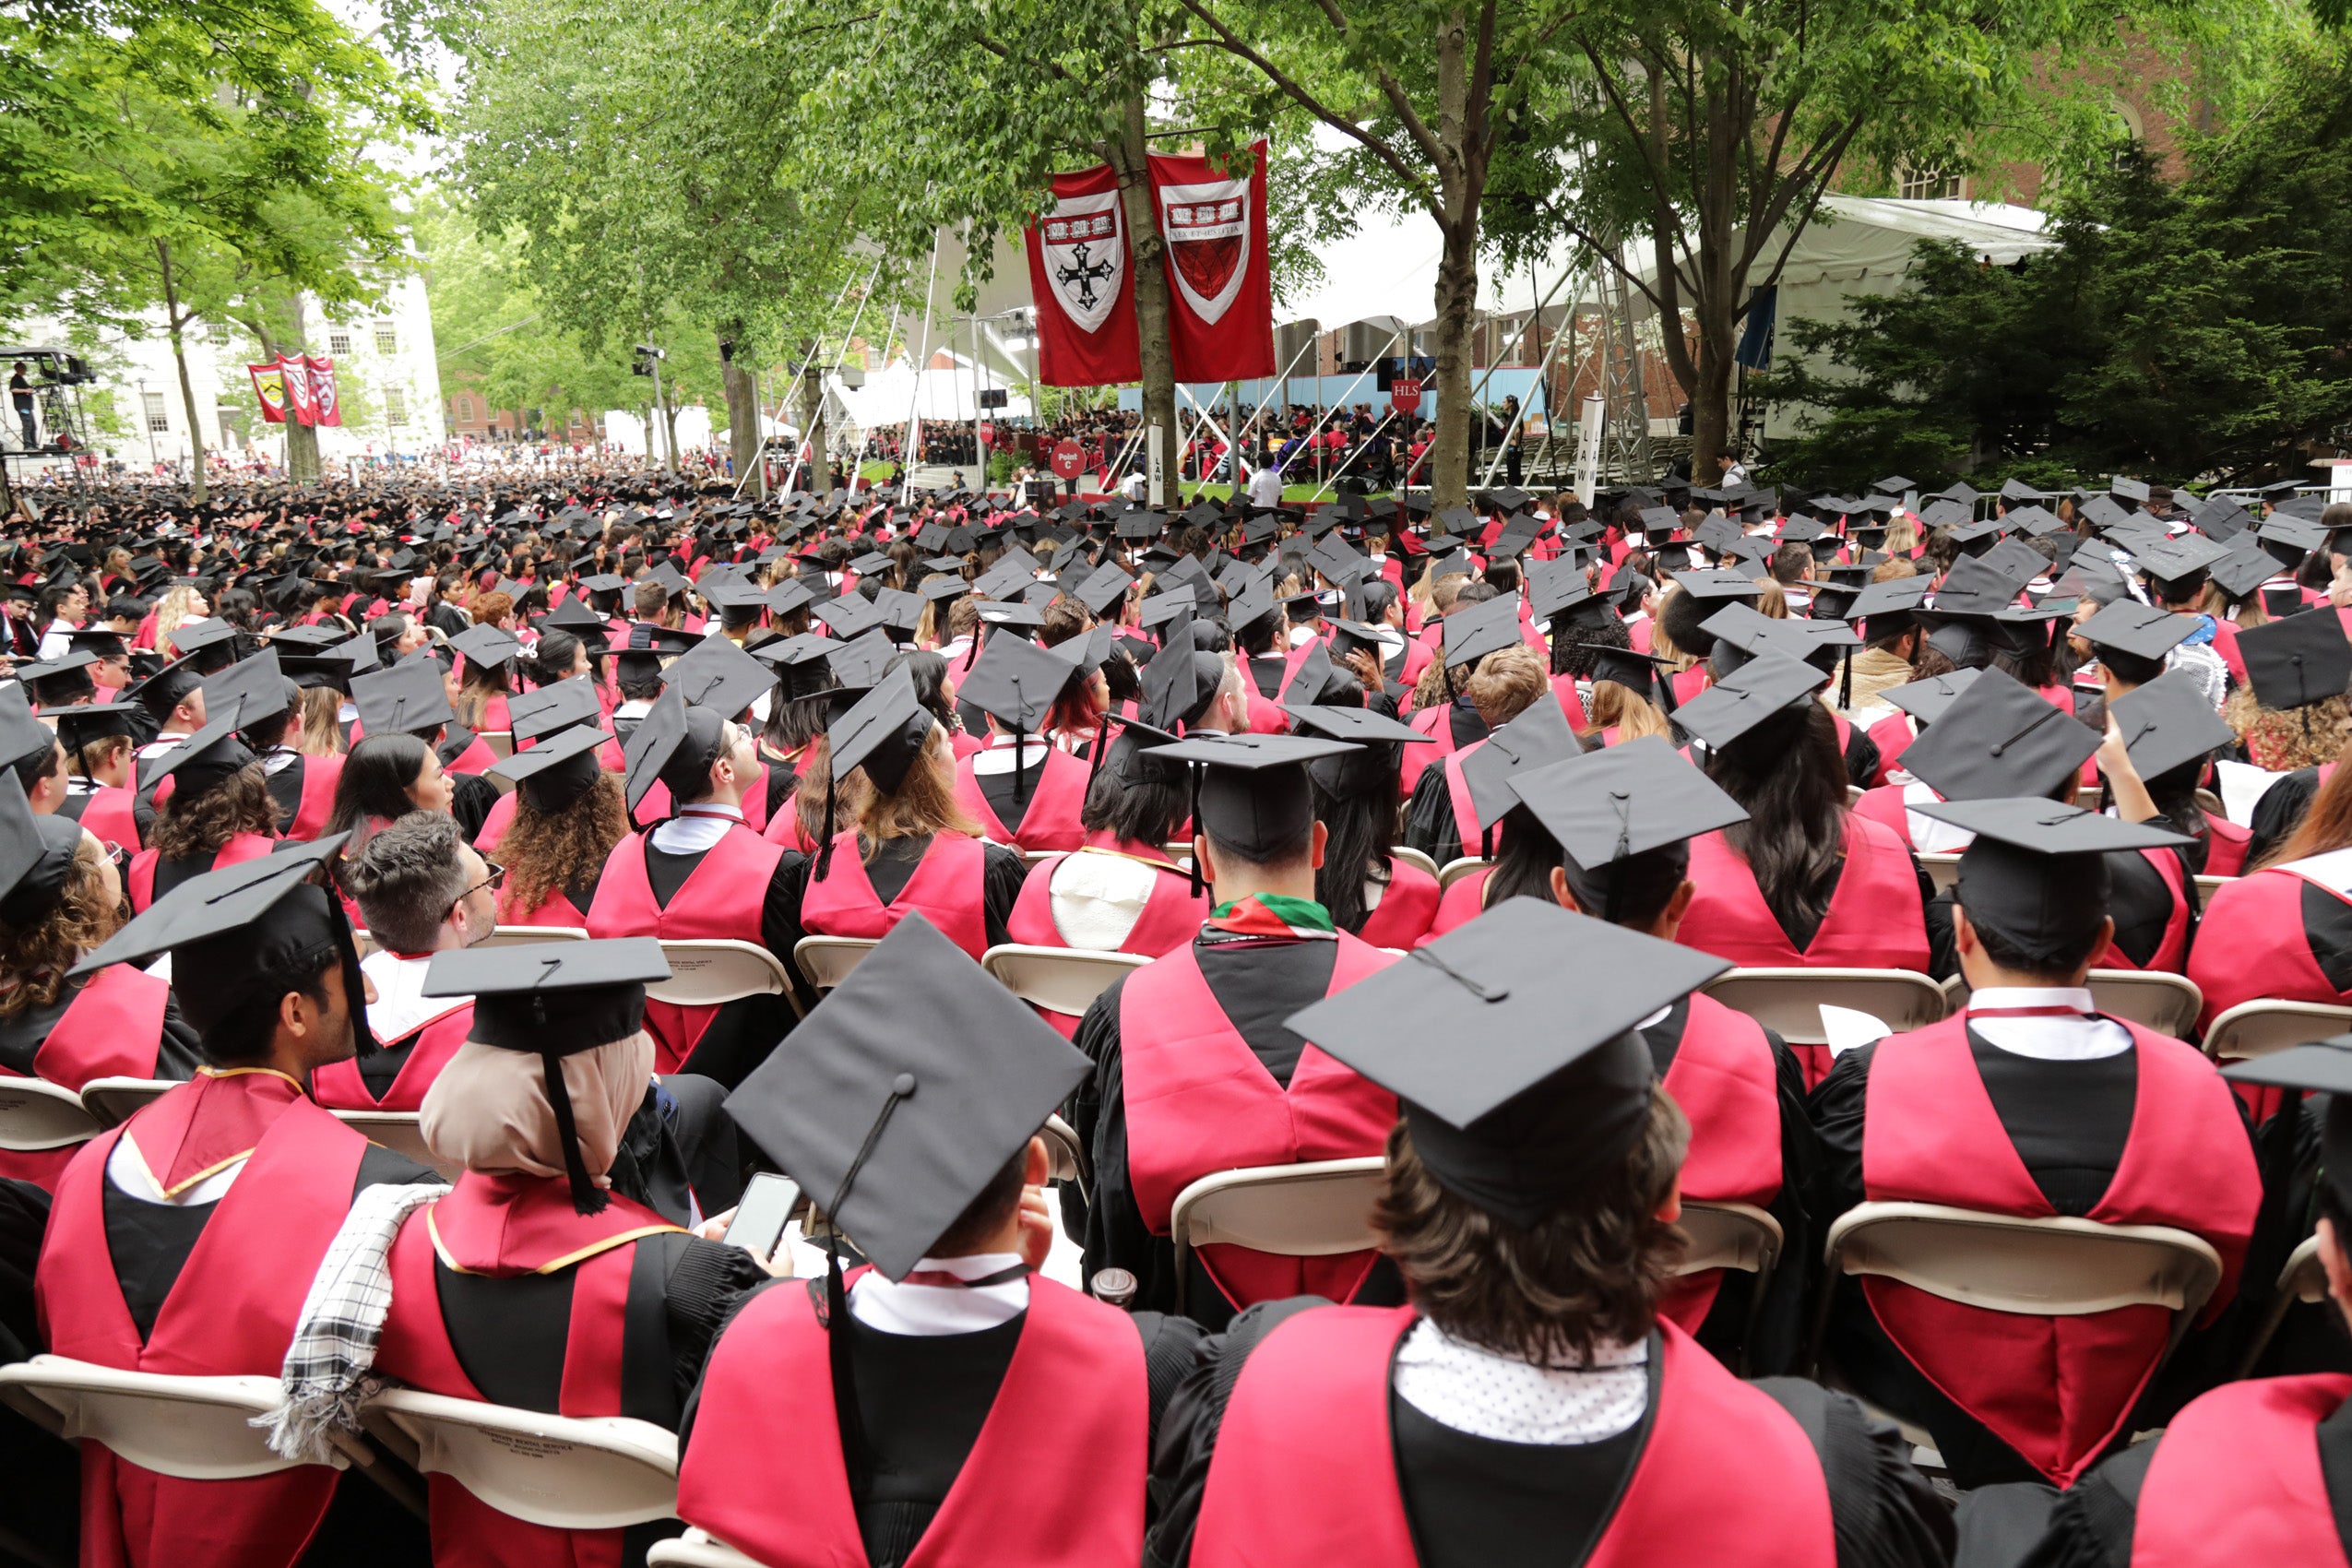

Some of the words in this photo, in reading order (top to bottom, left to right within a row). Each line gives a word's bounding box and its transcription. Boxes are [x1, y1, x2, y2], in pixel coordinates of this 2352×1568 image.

[1394, 385, 1419, 397] HLS
[1058, 452, 1078, 461] Point
[1578, 430, 1588, 481] LAW
[1064, 460, 1072, 469] C
[1154, 457, 1162, 482] LAW
